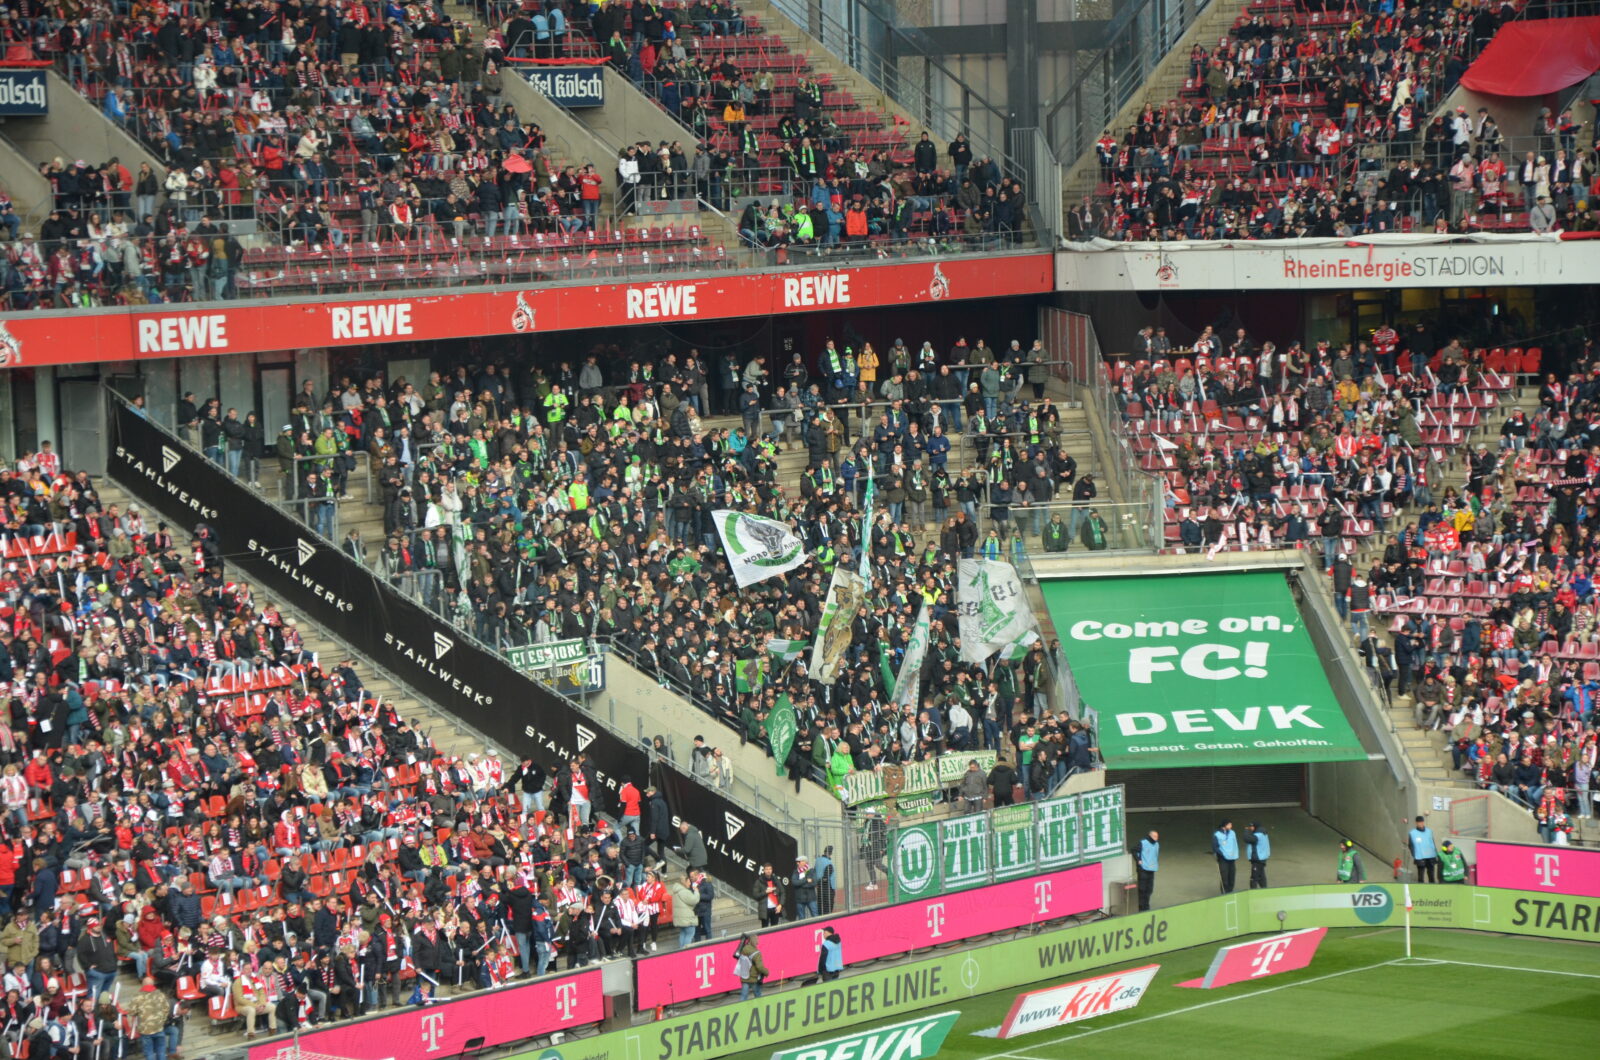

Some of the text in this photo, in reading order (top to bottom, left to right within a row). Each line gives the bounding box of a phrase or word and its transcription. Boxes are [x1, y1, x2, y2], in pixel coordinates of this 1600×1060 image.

[554, 73, 603, 100] Kölsch
[1284, 256, 1504, 282] RheinEnergieSTADION
[627, 285, 697, 319] REWE
[784, 274, 850, 307] REWE
[139, 314, 229, 352] REWE
[332, 303, 413, 339] REWE
[1070, 615, 1295, 641] Come on,
[1128, 641, 1270, 684] FC!
[1115, 705, 1325, 736] DEVK
[1128, 738, 1334, 754] Gesagt. Getan. Geholfen.
[1534, 853, 1560, 887] T
[1034, 880, 1051, 914] T
[1351, 893, 1383, 907] VRS
[927, 903, 945, 938] T
[1038, 915, 1169, 969] www.vrs.de
[1251, 937, 1293, 977] T
[695, 952, 715, 989] T
[556, 982, 577, 1021] T
[659, 966, 948, 1060] STARK AUF JEDER LINIE.
[1019, 978, 1140, 1024] www.kik.de
[421, 1012, 444, 1052] T
